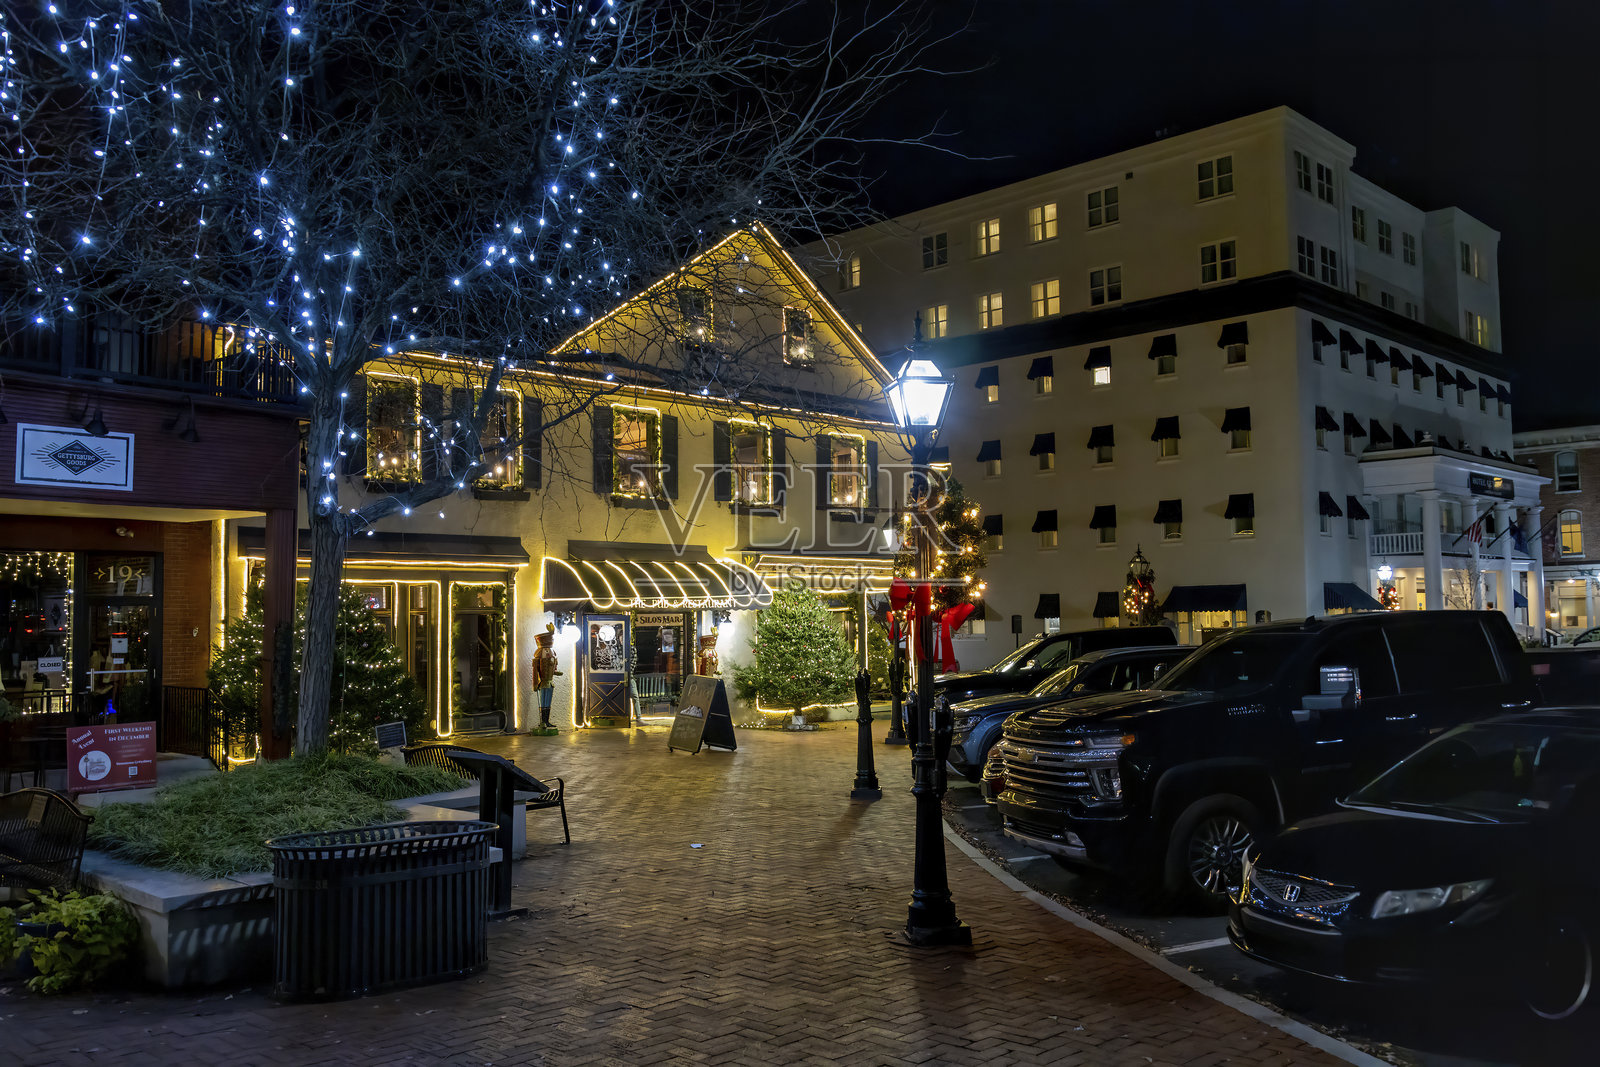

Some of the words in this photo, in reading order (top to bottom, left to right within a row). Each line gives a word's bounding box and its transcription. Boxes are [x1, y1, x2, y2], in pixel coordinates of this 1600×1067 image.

[58, 452, 96, 460] GETTYSBURG
[106, 565, 133, 584] 19
[630, 599, 646, 608] THE
[651, 599, 669, 609] PUB
[683, 598, 737, 609] RESTAURANT
[71, 730, 93, 744] Annual
[78, 738, 94, 750] Event
